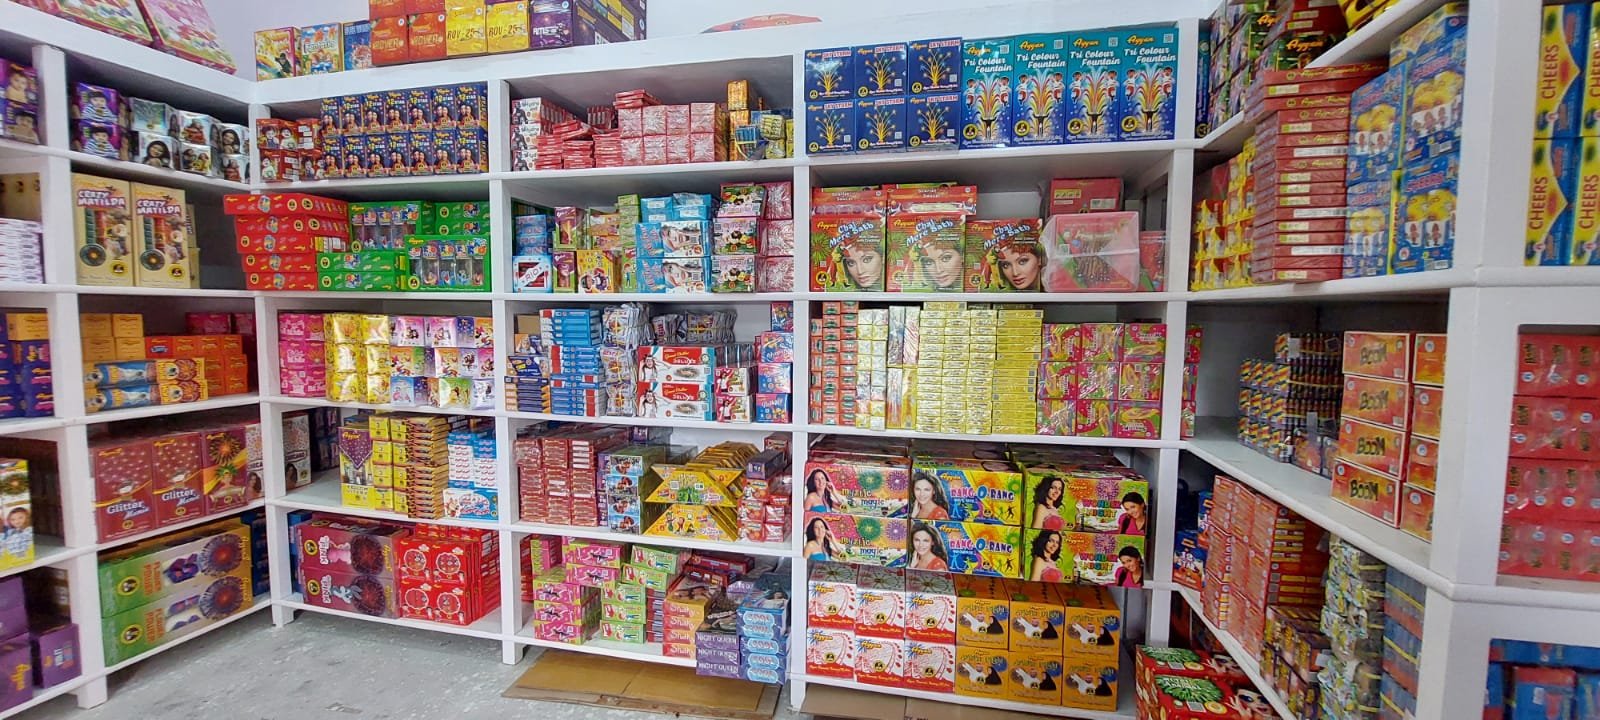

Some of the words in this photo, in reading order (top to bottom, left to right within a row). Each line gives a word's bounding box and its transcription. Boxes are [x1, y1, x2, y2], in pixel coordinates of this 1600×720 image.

[1016, 53, 1029, 62] Tri
[1030, 51, 1059, 61] Colour
[1070, 51, 1082, 59] Tri
[1084, 49, 1114, 58] Colour
[1124, 48, 1137, 57] Tri
[1139, 47, 1169, 56] Colour
[964, 58, 977, 67] Tri
[978, 57, 1006, 66] Colour
[1027, 60, 1066, 69] Fountain
[1082, 57, 1120, 66] Fountain
[1136, 54, 1176, 64] Fountain
[975, 64, 1012, 73] Fountain
[1542, 44, 1559, 99] CHEERS
[78, 189, 109, 199] CRAZY
[77, 196, 125, 207] MATILDA
[137, 199, 166, 208] CRAZY
[1529, 176, 1548, 230] CHEERS
[1579, 174, 1599, 229] CHEERS
[137, 205, 181, 215] MATILDA
[828, 231, 851, 249] Mere
[906, 230, 929, 247] Mere
[983, 233, 1006, 250] Mere
[525, 268, 539, 281] RIO
[1359, 390, 1389, 410] BOOM
[1356, 436, 1386, 456] BOOM
[161, 488, 194, 502] Glitter
[1350, 480, 1379, 501] BOOM
[106, 500, 143, 514] Glitter
